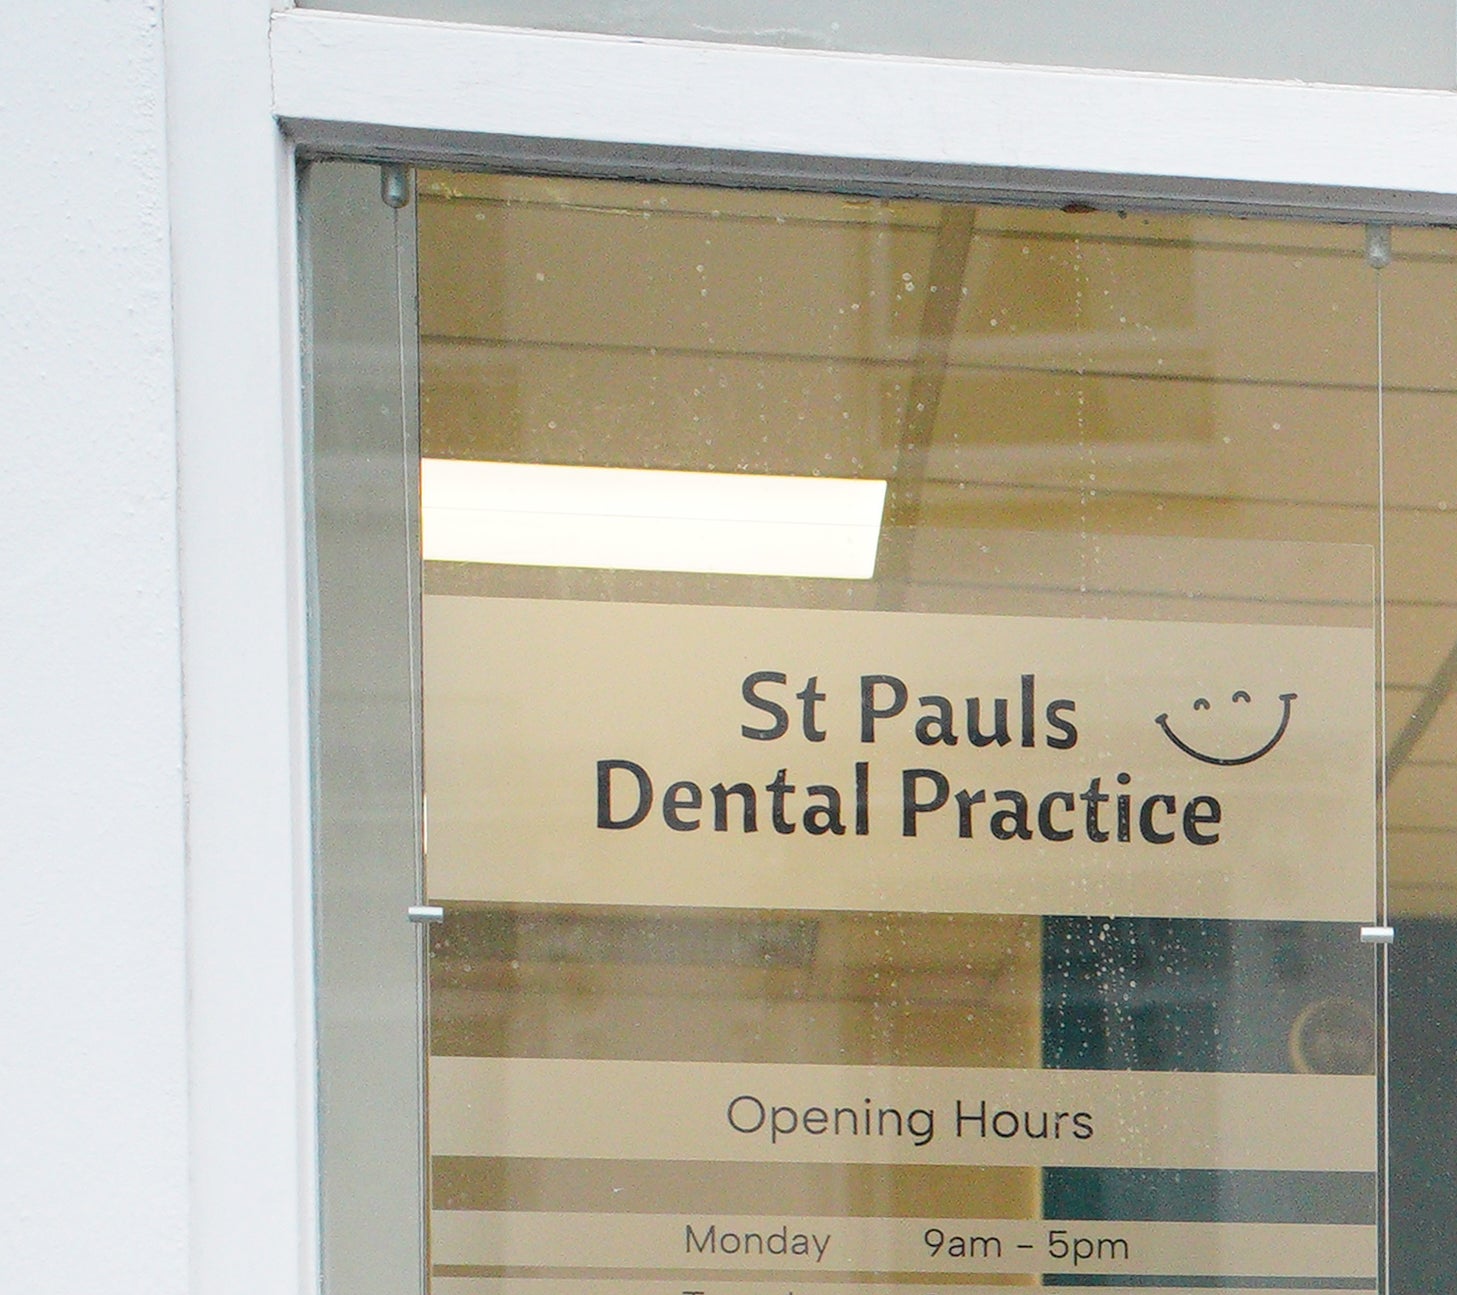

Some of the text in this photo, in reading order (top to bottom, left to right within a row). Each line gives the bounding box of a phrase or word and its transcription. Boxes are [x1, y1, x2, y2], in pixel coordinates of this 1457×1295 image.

[741, 670, 1079, 751] St Pauls
[596, 759, 1222, 847] Dental Practice
[727, 1095, 1094, 1148] Opening Hours
[685, 1224, 832, 1263] Monday
[924, 1228, 1002, 1258] 9am
[1048, 1229, 1129, 1267] 5pm
